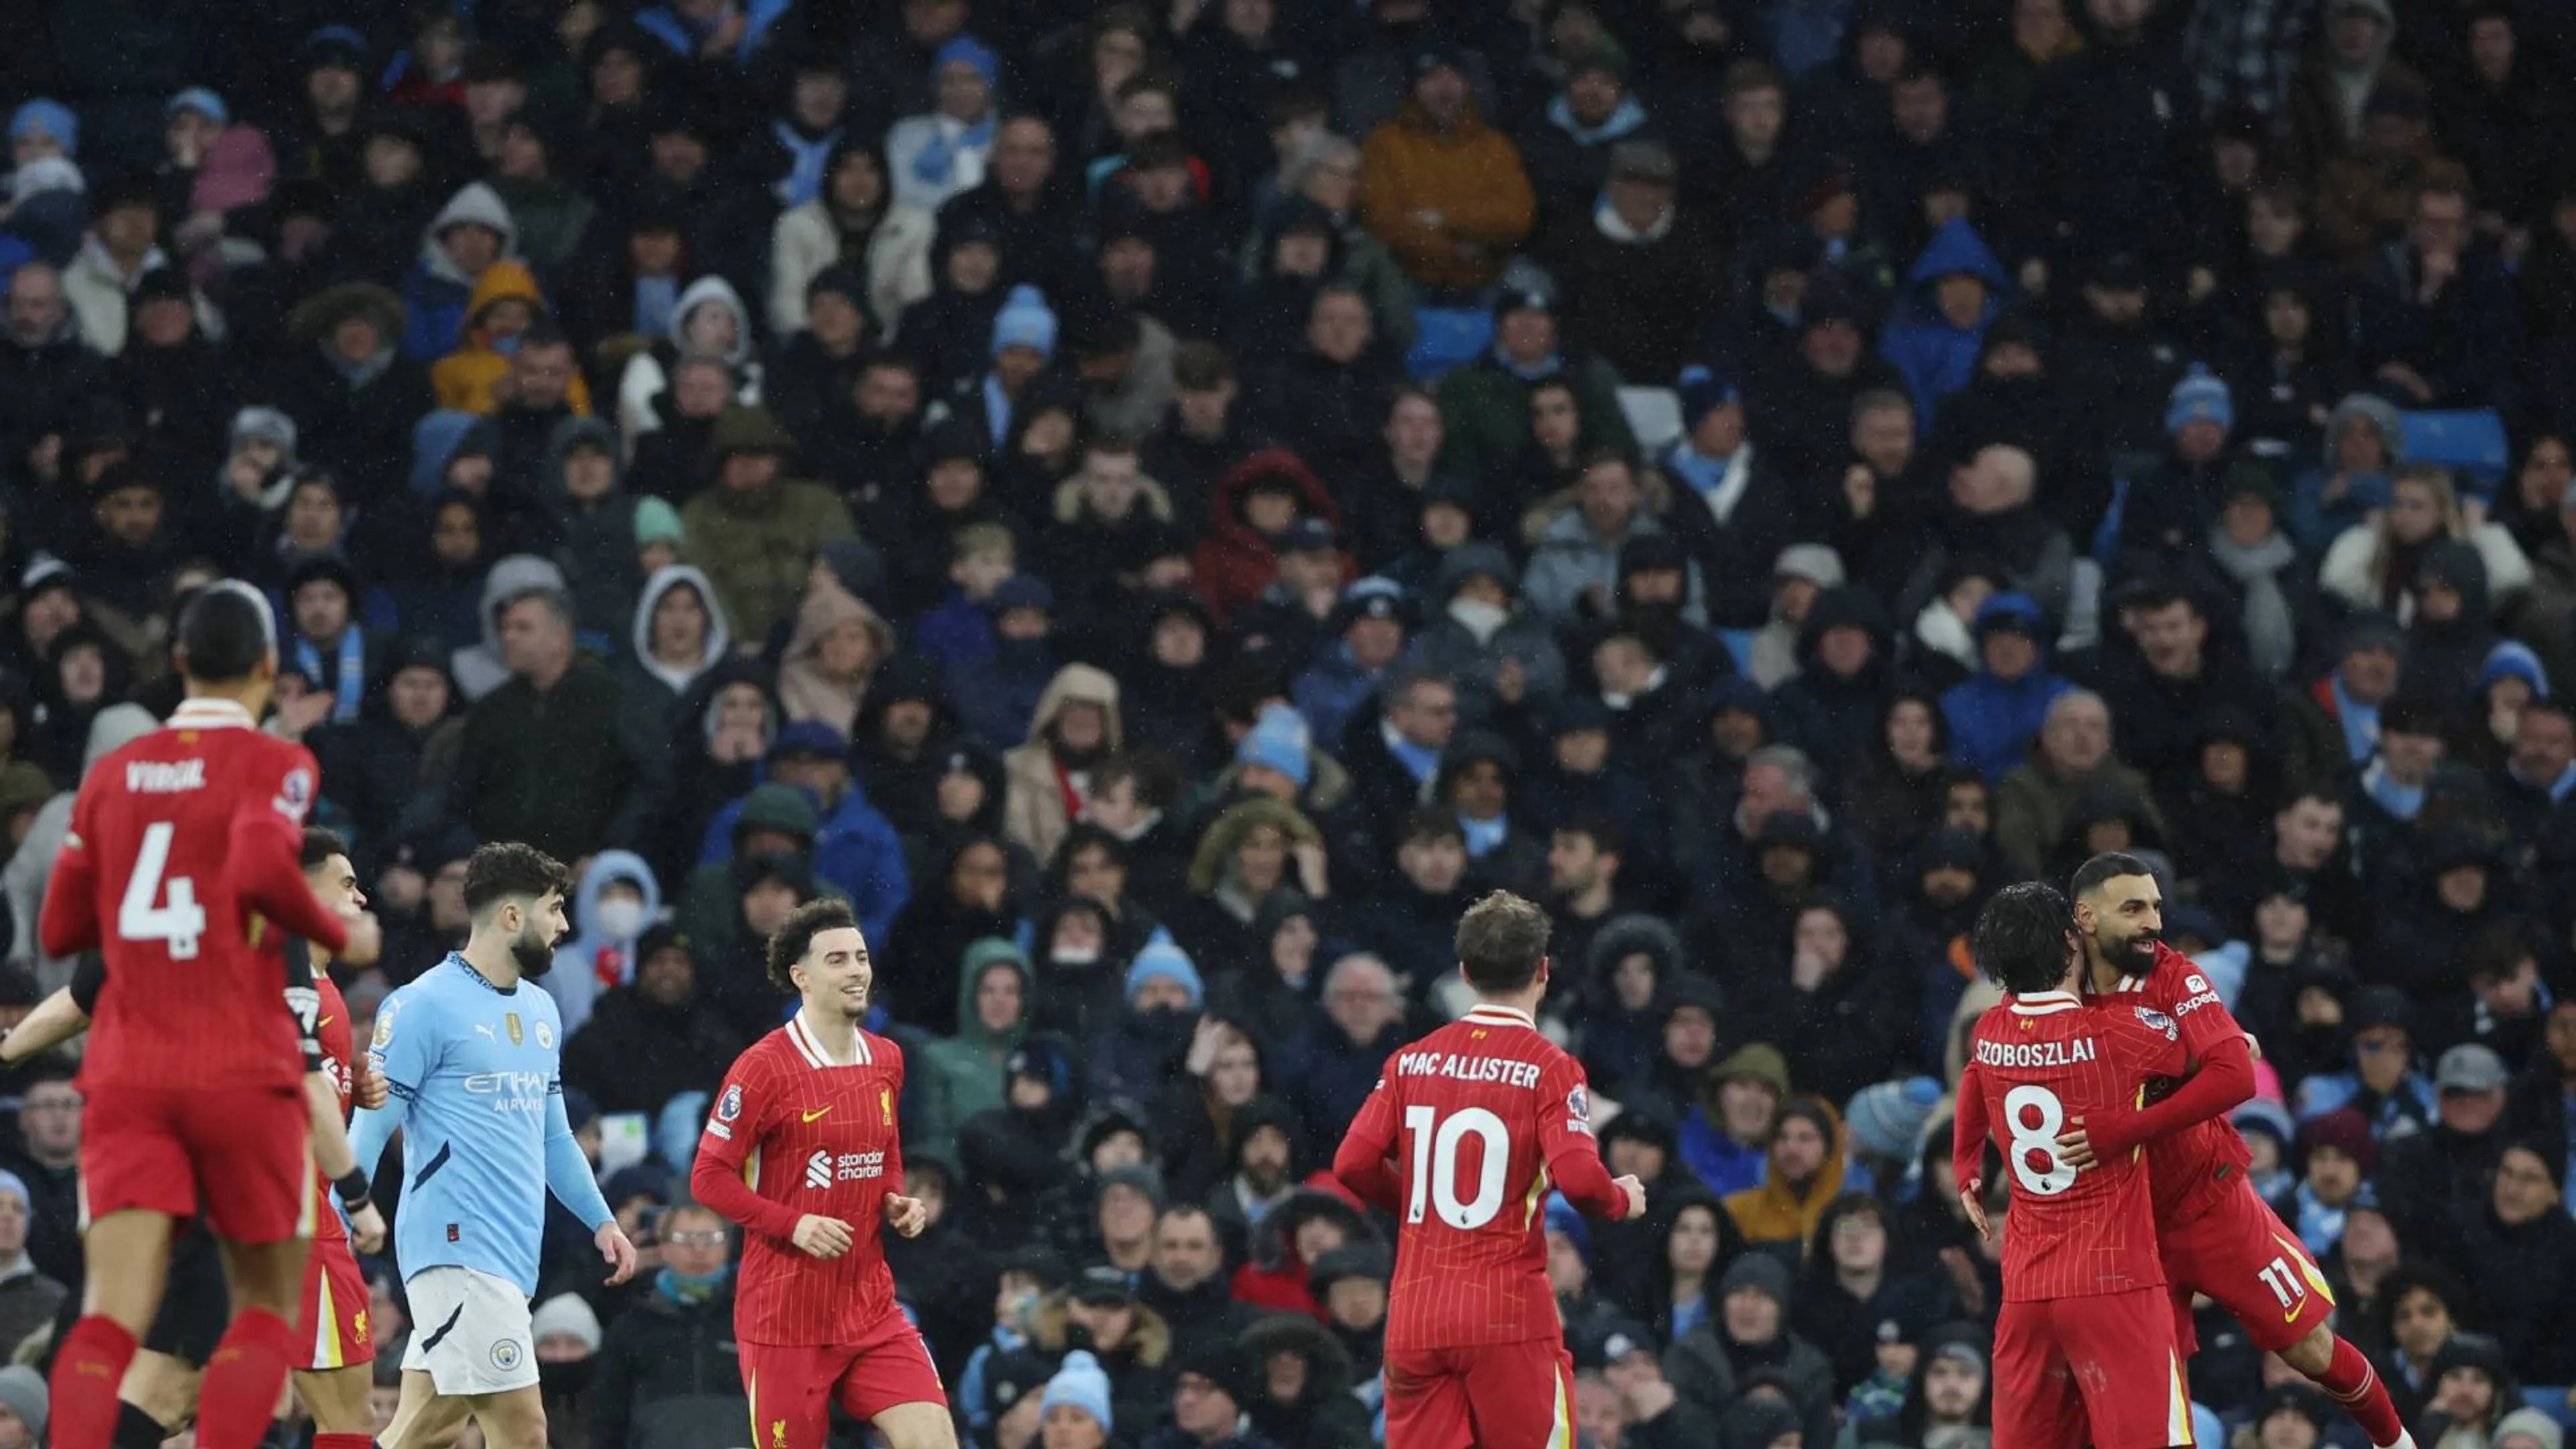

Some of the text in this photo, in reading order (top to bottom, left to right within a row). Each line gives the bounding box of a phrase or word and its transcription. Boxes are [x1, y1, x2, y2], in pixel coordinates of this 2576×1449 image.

[118, 821, 207, 961] 4
[1398, 1053, 1540, 1089] MAC ALLISTER
[1976, 1037, 2096, 1067] SZOBOSZLAI
[1405, 1105, 1509, 1230] 10
[2004, 1085, 2077, 1195] 8
[2257, 1256, 2304, 1308] 11
